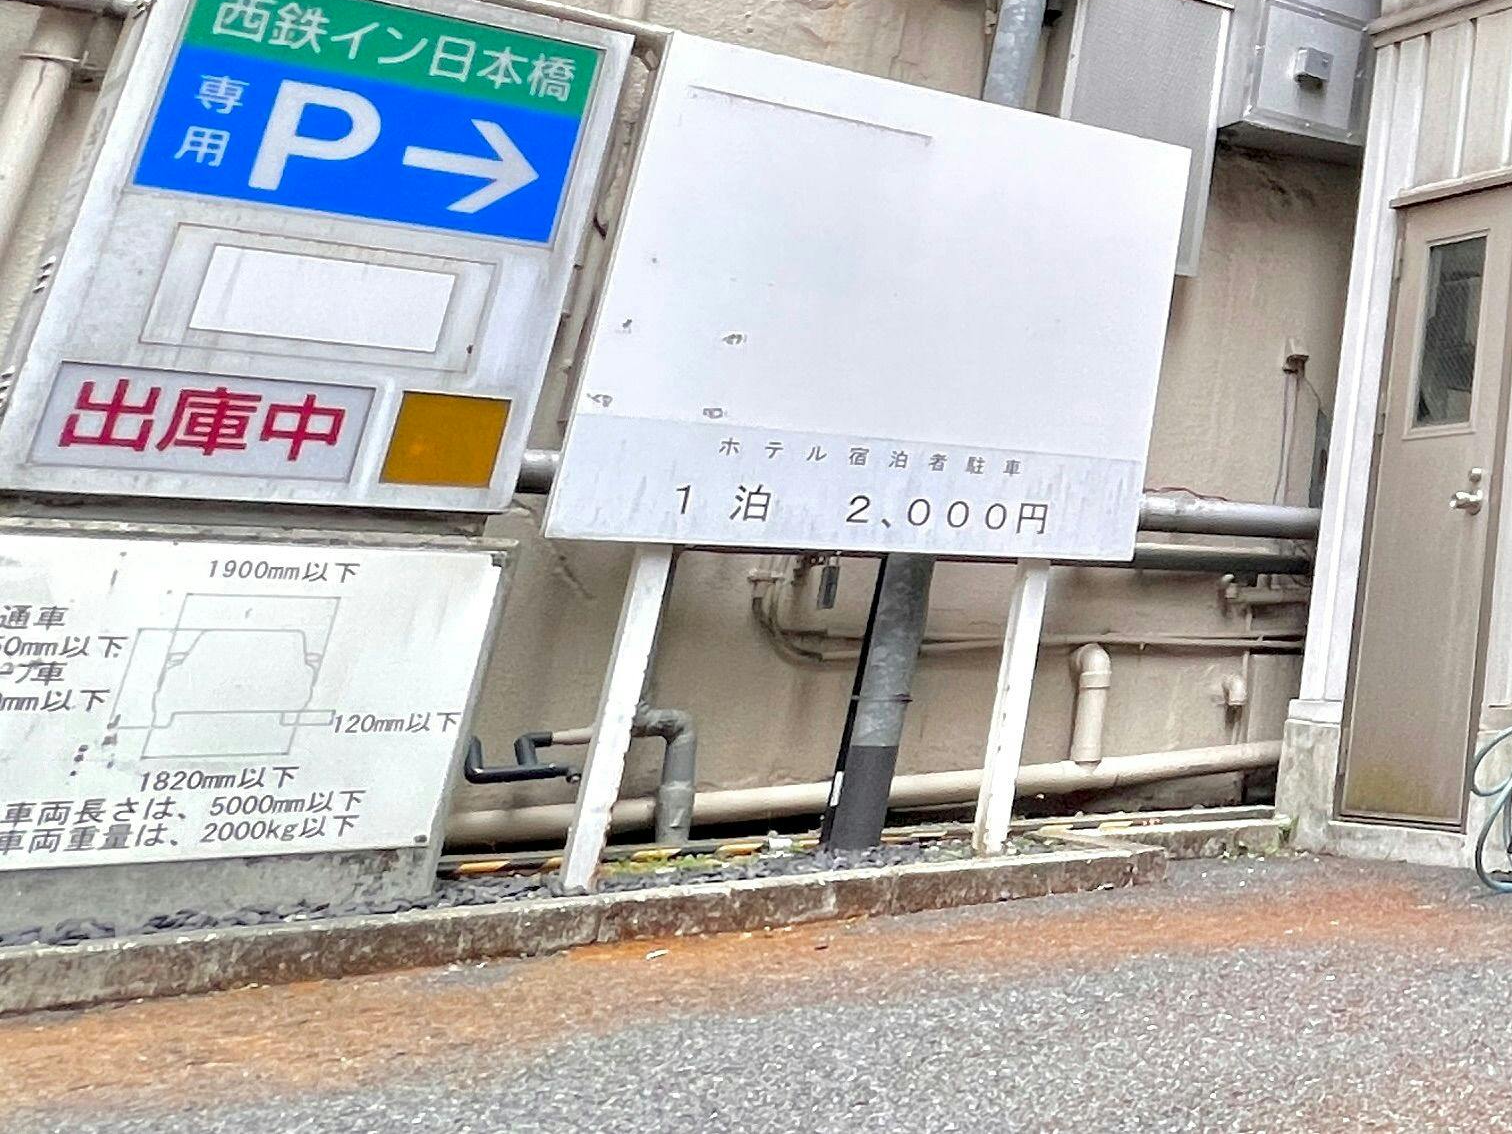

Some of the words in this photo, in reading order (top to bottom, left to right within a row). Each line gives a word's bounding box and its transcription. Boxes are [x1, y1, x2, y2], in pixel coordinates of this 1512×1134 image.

[173, 74, 251, 167] 専用
[247, 78, 382, 192] P
[56, 376, 349, 463] 出庫中
[717, 437, 1025, 477] ホテル宿泊者駐車
[207, 559, 361, 584] 1900mm以下
[0, 635, 129, 659] 0mm以下
[333, 710, 461, 735] 120mm以下
[138, 766, 300, 793] 1820mm以下
